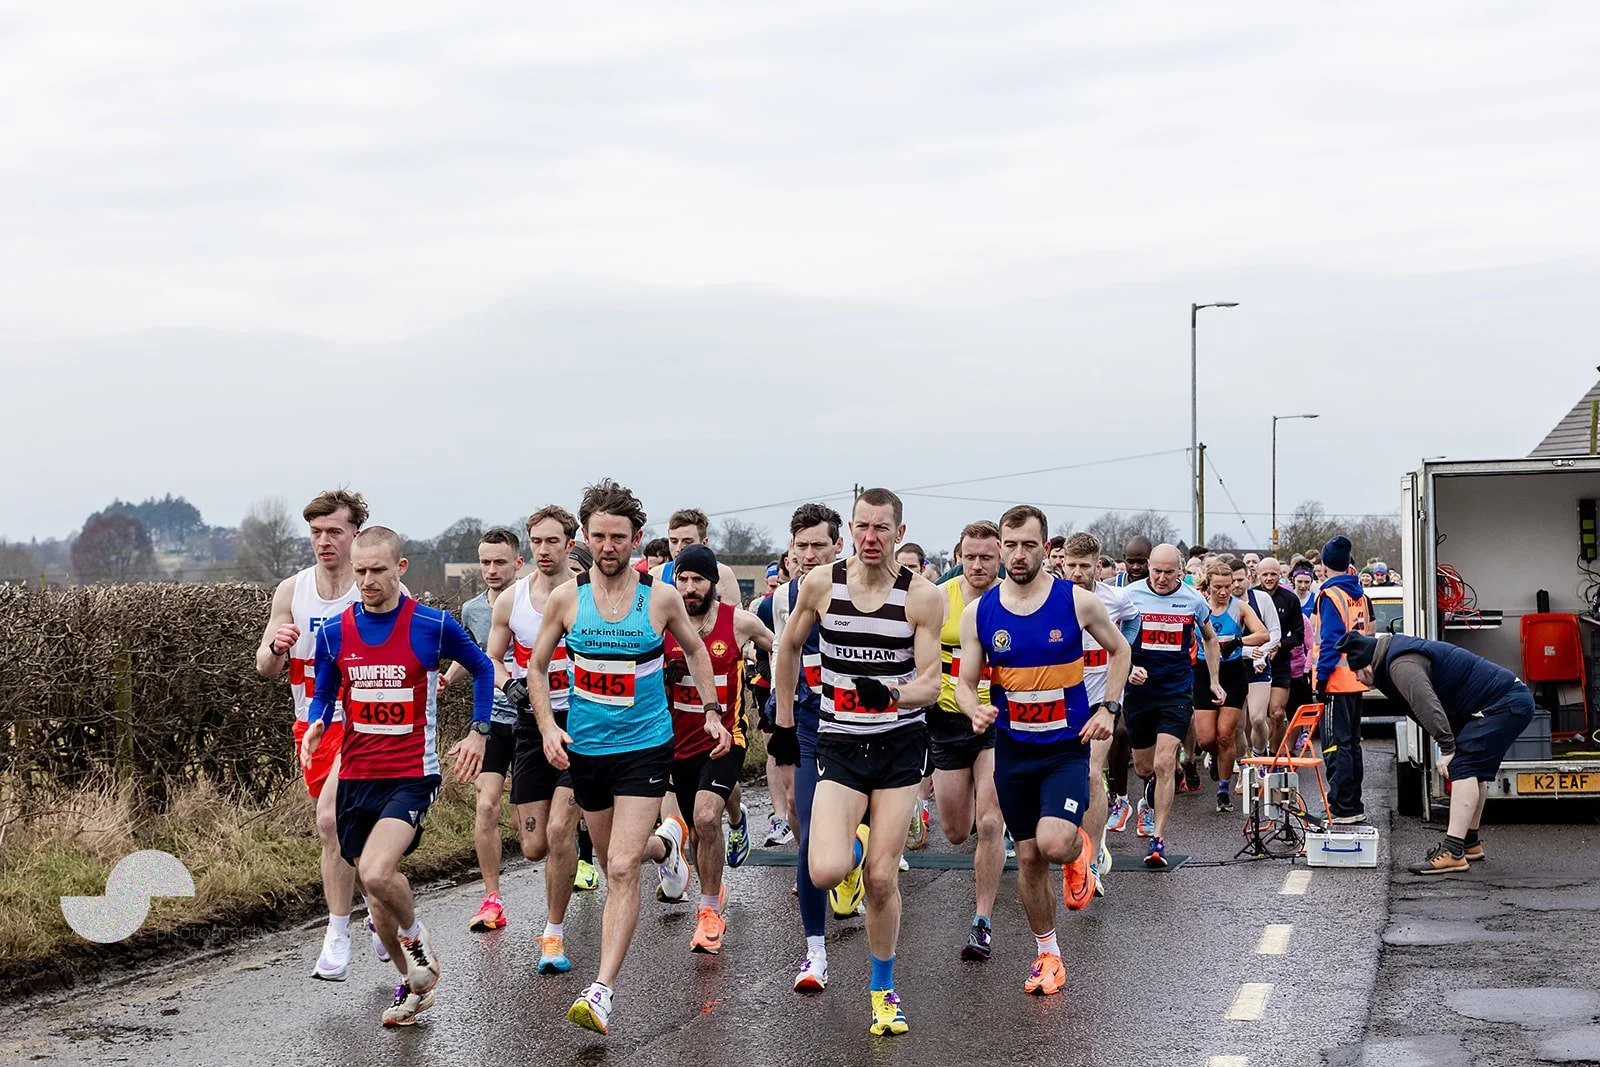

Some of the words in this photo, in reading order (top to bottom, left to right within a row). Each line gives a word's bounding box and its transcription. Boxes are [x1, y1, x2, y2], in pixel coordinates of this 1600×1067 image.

[636, 594, 645, 612] soar
[1152, 615, 1190, 623] WARRIORS
[581, 628, 644, 637] Kirkintilloch
[1148, 630, 1177, 645] 408
[584, 639, 640, 649] Olympians
[835, 646, 896, 661] FULHAM
[1084, 650, 1101, 666] 41
[348, 665, 407, 681] DUMFRIES
[384, 680, 402, 688] CLUB
[580, 671, 626, 696] 445
[680, 685, 703, 704] 34
[360, 702, 405, 724] 469
[1016, 703, 1057, 723] 227
[1534, 775, 1555, 790] K2
[1559, 775, 1589, 790] EAF
